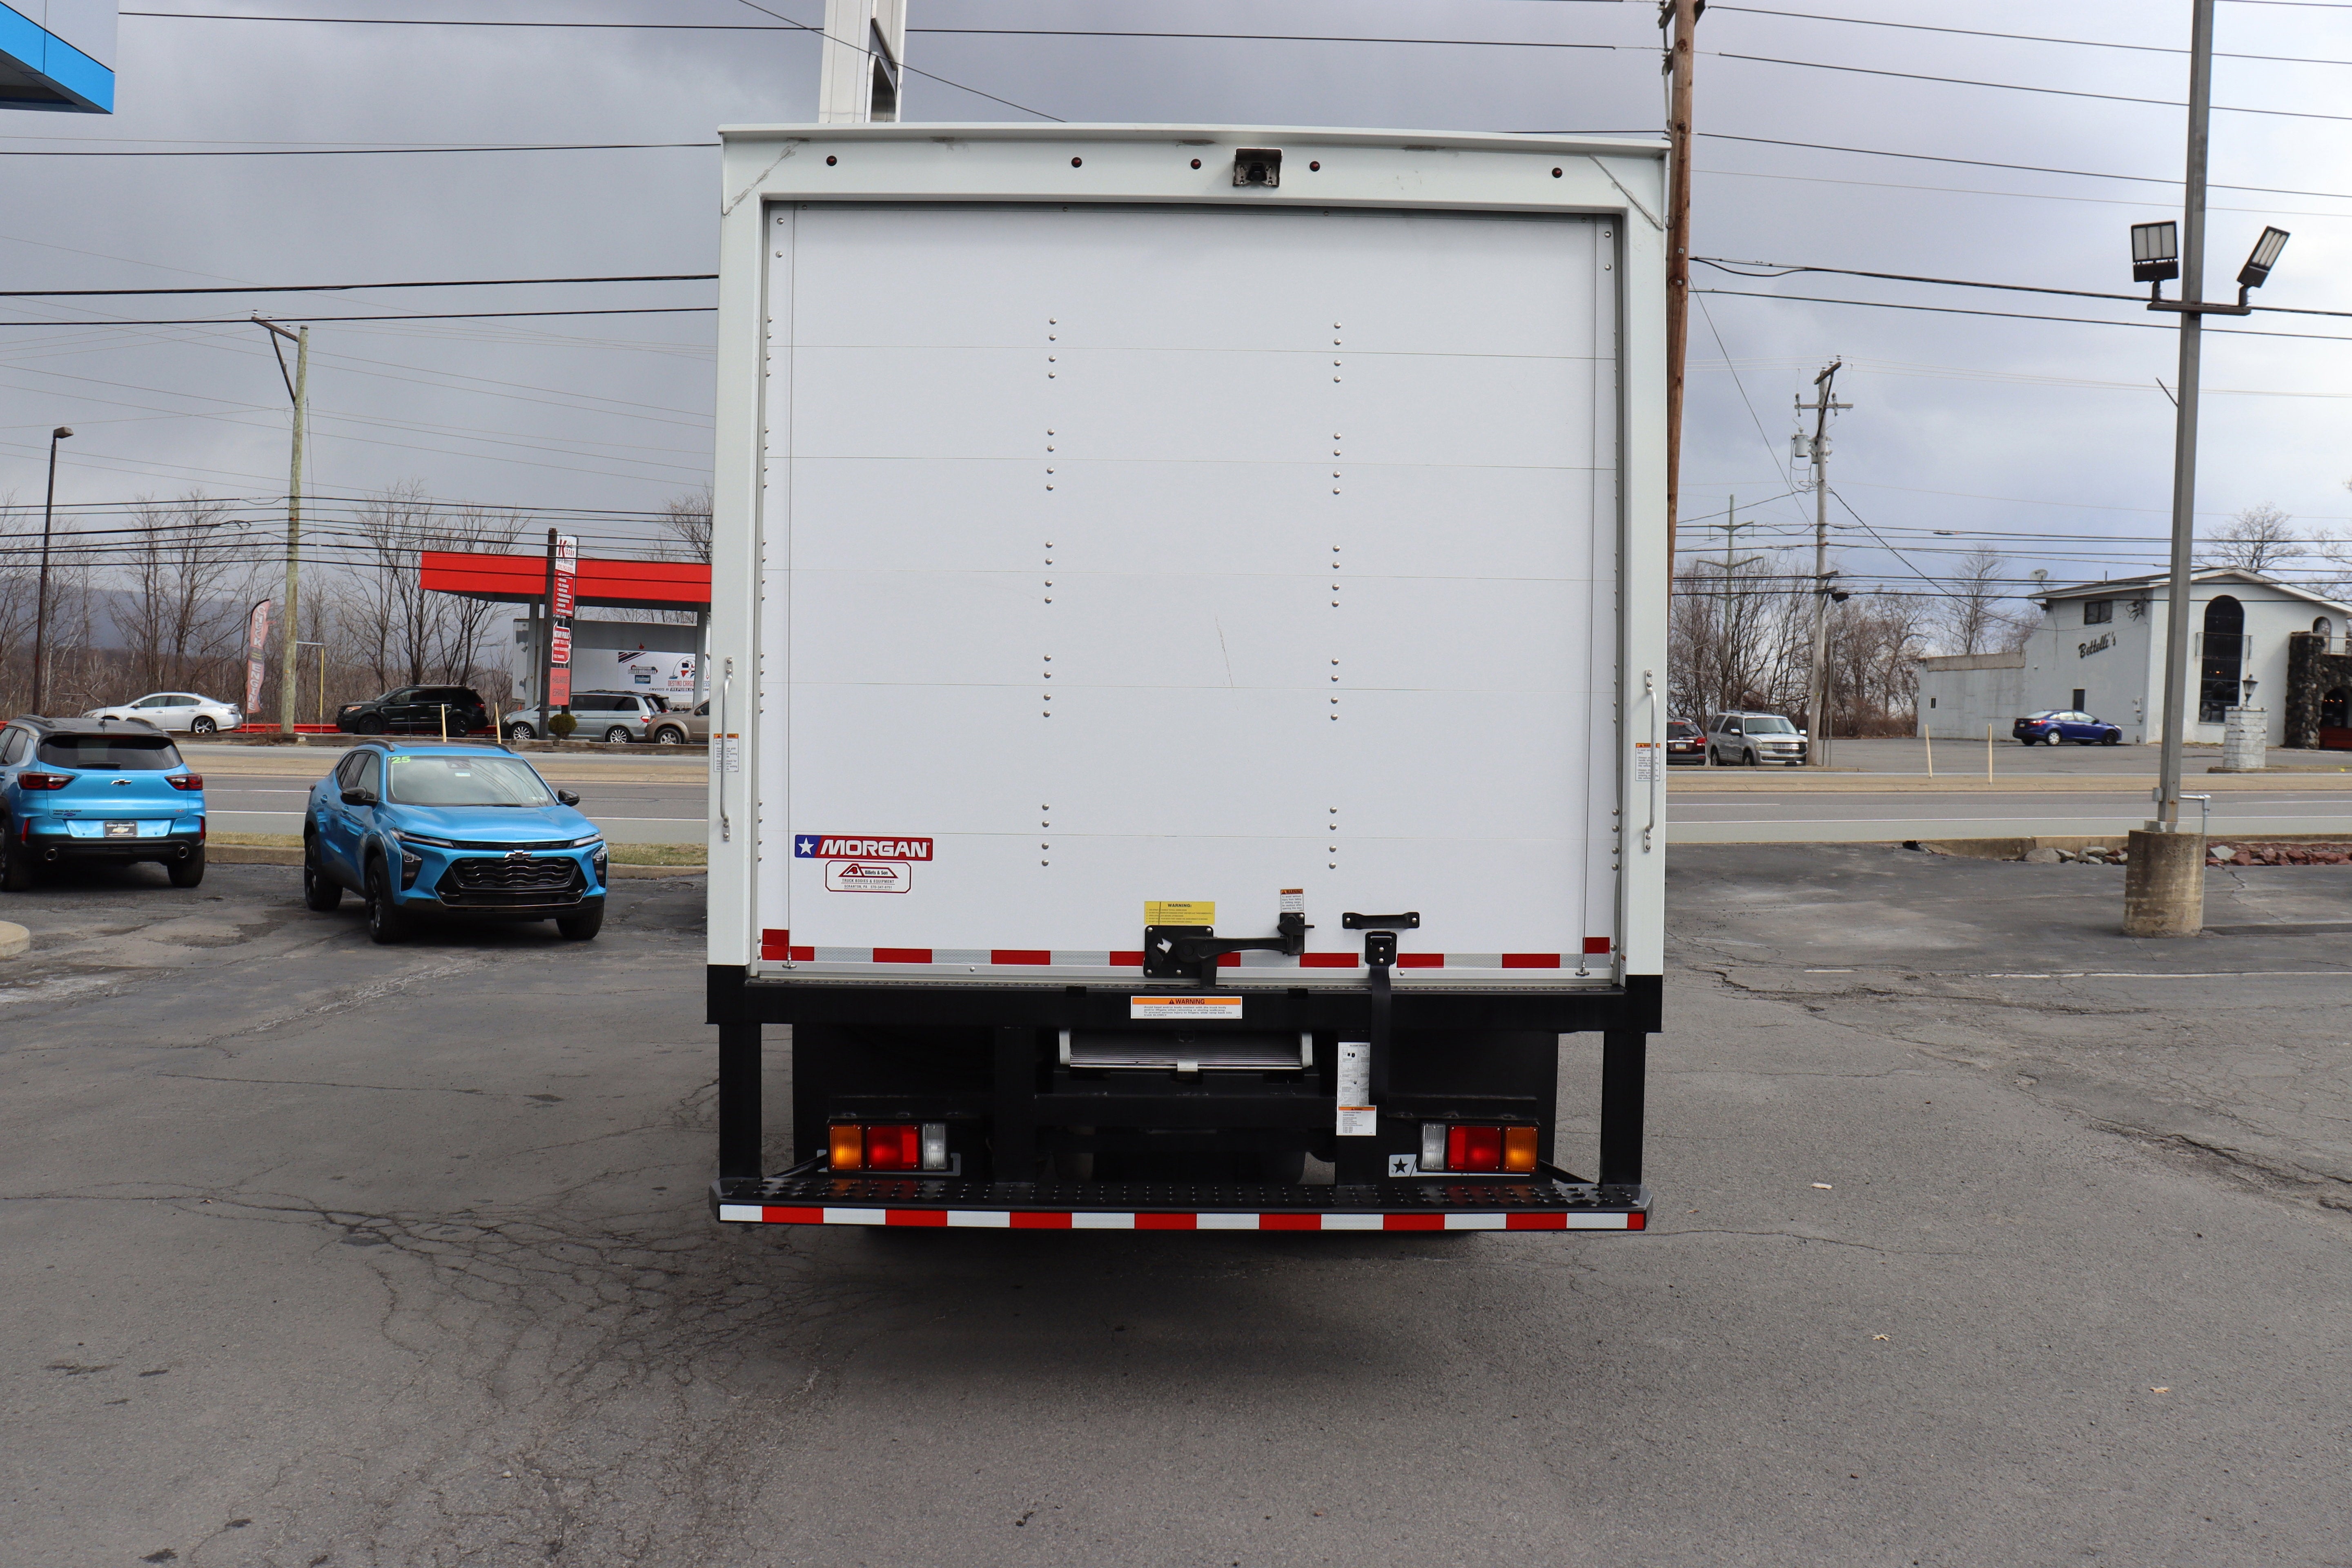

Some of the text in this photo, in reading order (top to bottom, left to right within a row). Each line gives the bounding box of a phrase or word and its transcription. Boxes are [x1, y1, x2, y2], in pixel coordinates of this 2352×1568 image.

[254, 605, 265, 648] CHECK
[2078, 631, 2116, 659] Bettelli's
[247, 663, 261, 711] ENGINE
[820, 839, 927, 858] MORGAN
